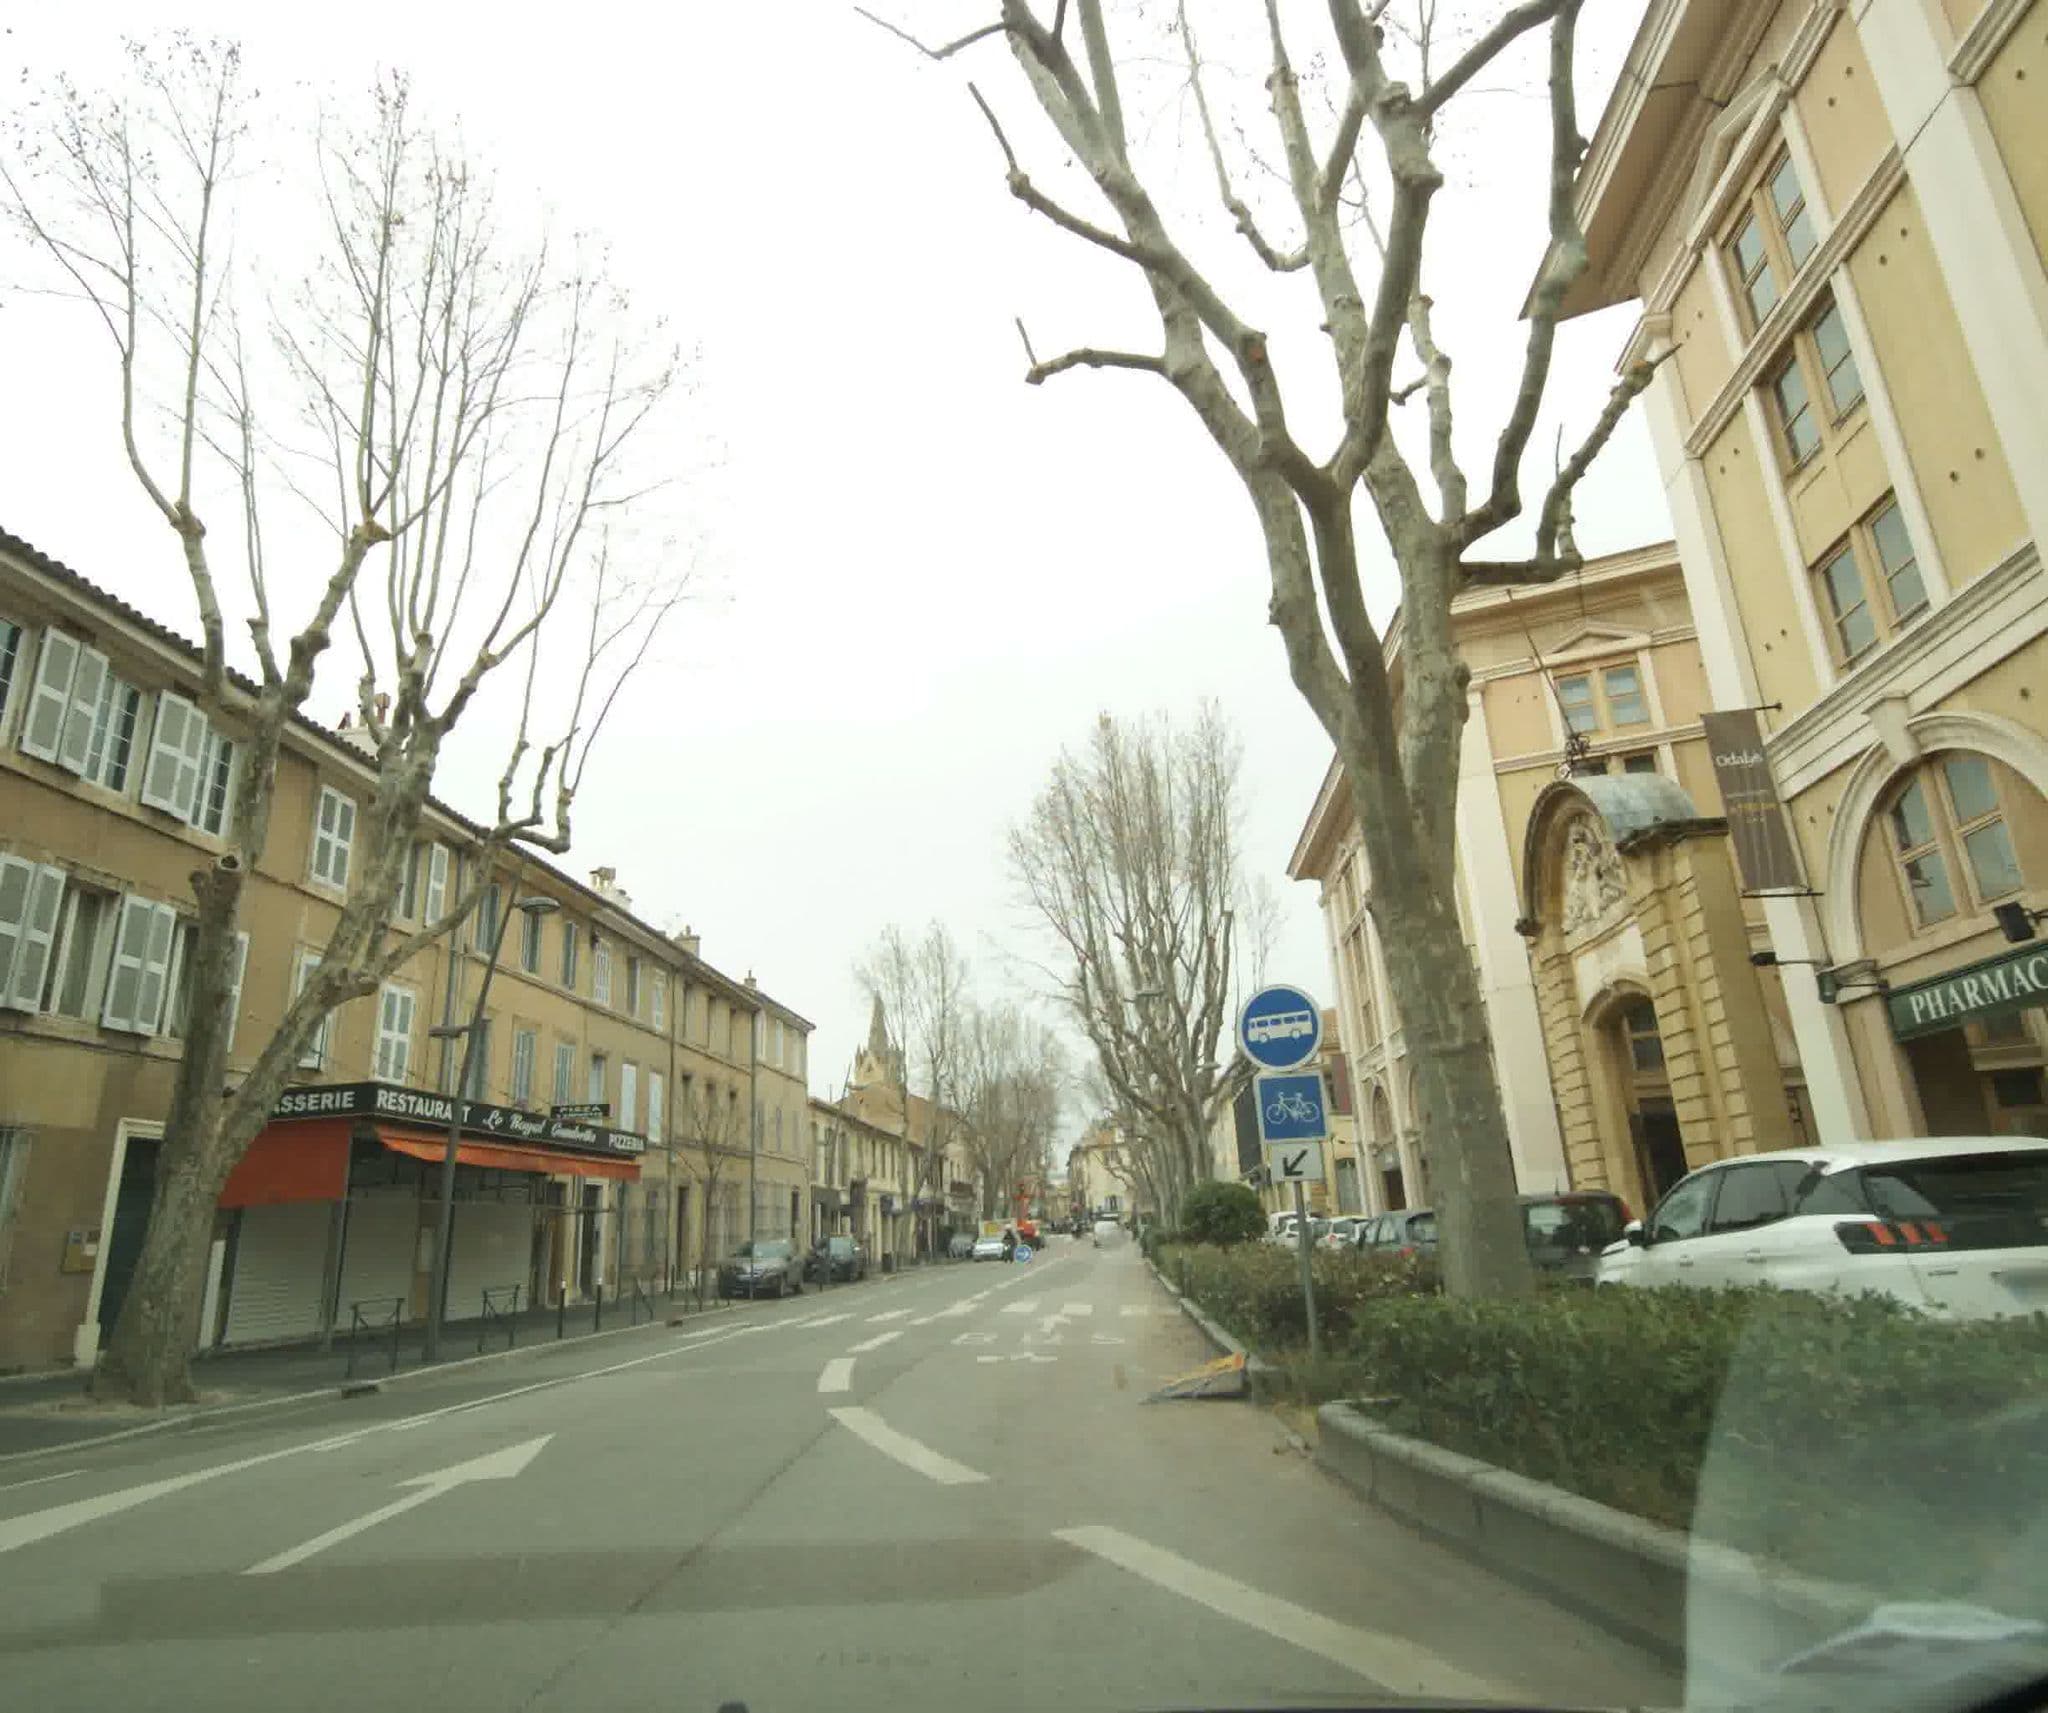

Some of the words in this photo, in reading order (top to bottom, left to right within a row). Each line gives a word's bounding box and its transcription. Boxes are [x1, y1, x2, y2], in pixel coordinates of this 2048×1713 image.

[1909, 956, 2048, 1025] PHARMAC
[273, 1091, 355, 1115] SSERIE
[376, 1089, 471, 1123] RESTAURAT
